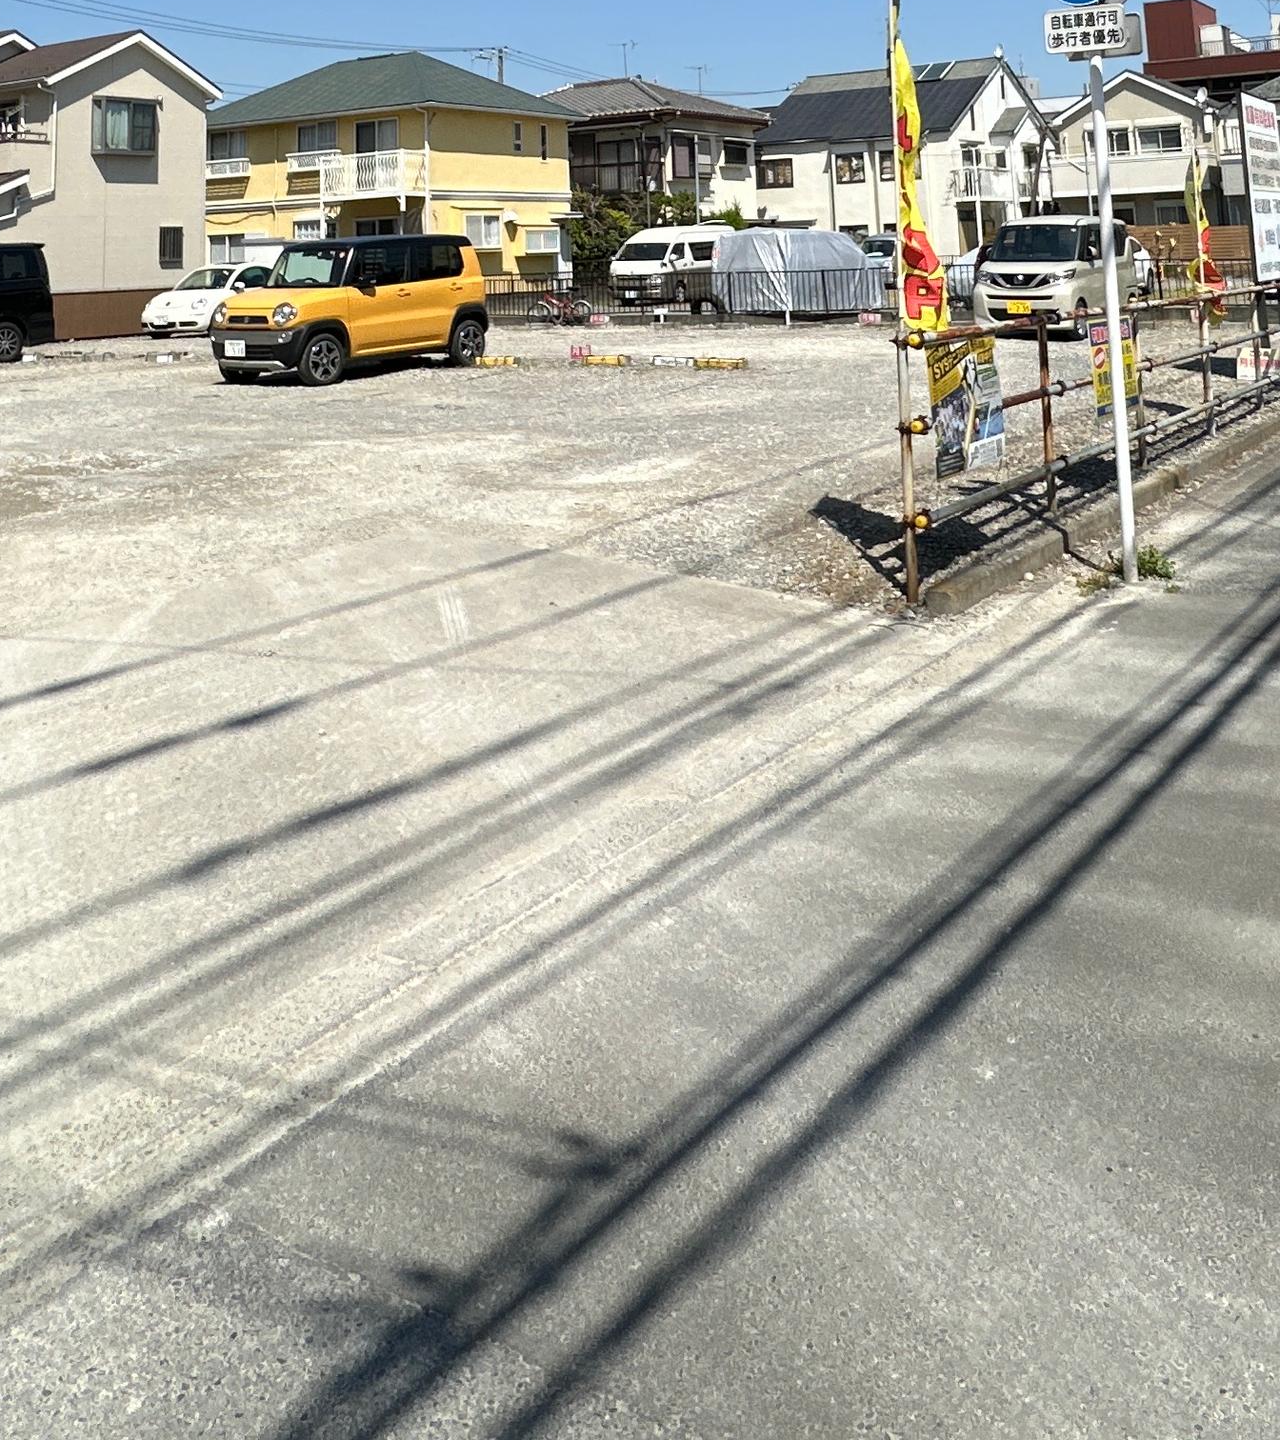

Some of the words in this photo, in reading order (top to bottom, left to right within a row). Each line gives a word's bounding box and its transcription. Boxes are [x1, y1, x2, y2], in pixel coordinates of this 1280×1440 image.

[1050, 10, 1119, 30] 自転車通行可
[1047, 27, 1125, 49] (歩行者優先)
